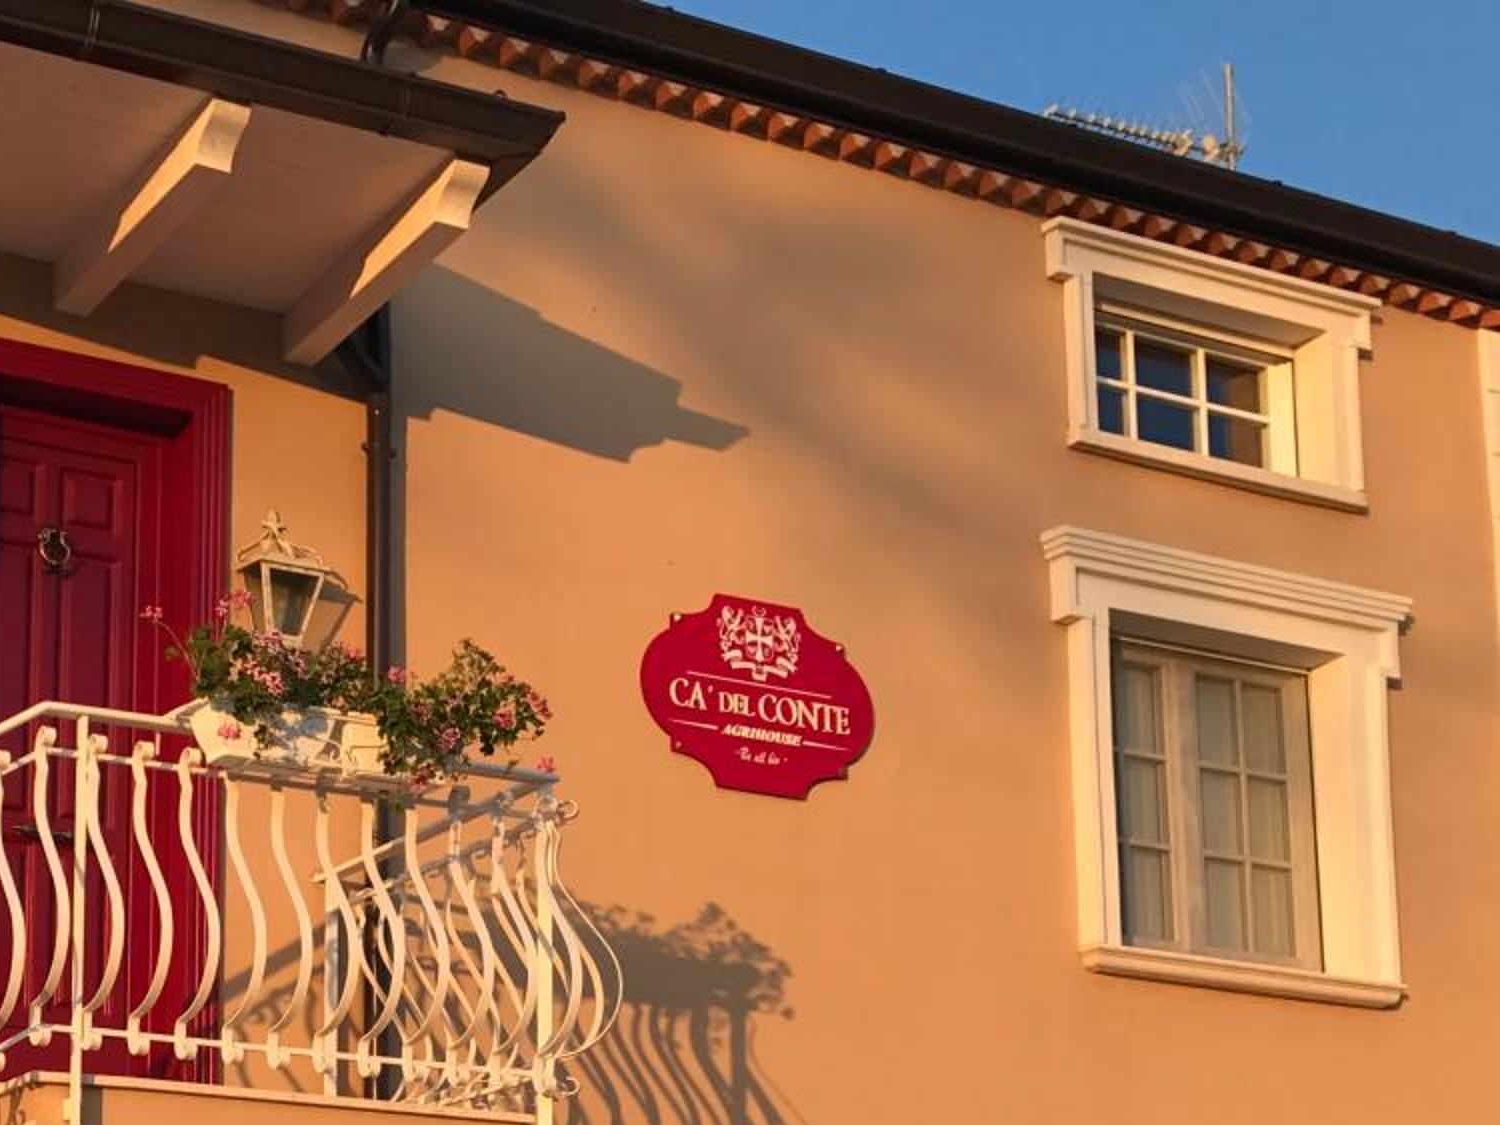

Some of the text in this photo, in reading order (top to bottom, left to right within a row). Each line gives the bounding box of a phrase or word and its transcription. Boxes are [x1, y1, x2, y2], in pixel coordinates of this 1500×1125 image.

[718, 692, 756, 717] DEL
[758, 694, 851, 735] CONTE
[721, 723, 803, 747] AGRIHOUSE
